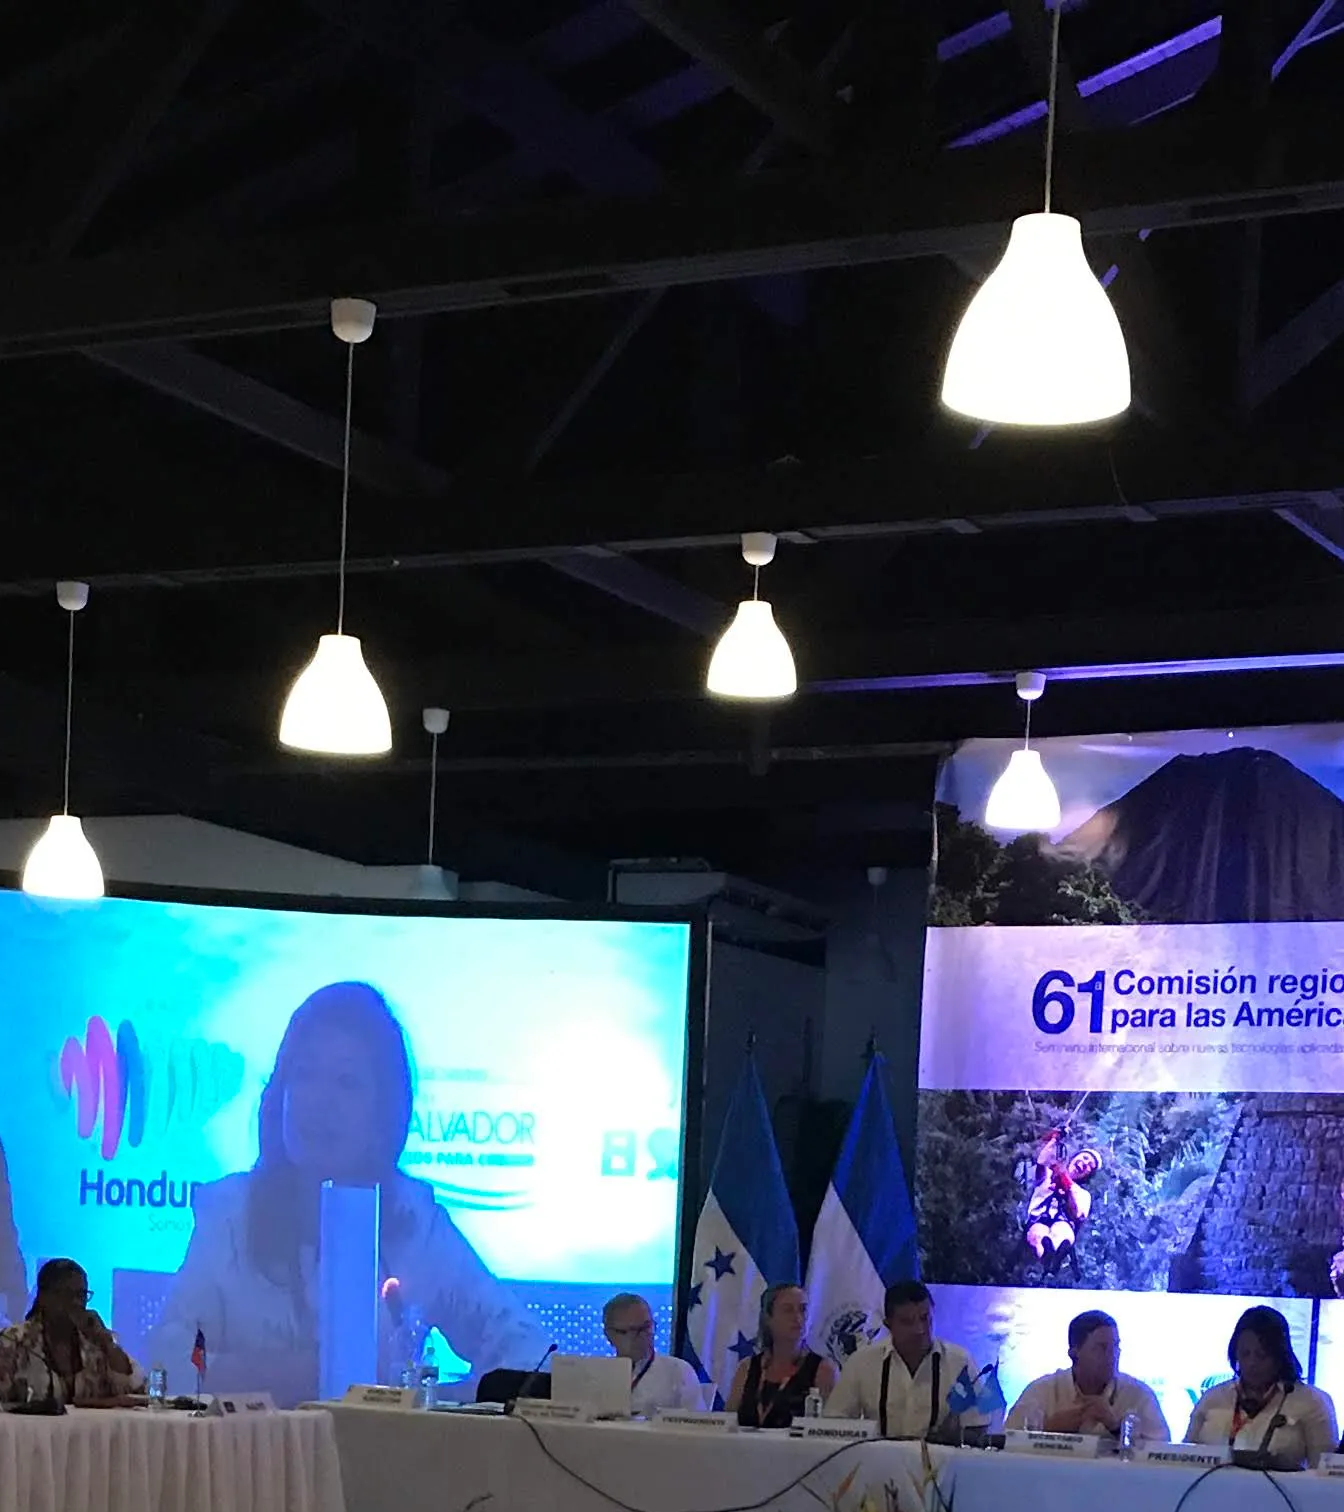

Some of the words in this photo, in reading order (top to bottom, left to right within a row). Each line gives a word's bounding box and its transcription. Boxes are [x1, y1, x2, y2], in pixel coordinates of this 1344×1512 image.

[1113, 966, 1257, 995] Comisión
[1031, 969, 1105, 1034] 61
[1110, 1005, 1177, 1033] para
[1185, 1002, 1226, 1028] las
[408, 1110, 535, 1144] ALVADOR
[80, 1168, 202, 1208] Hondur
[807, 1428, 868, 1438] HONDURAS
[1148, 1452, 1222, 1465] PRESIDENTE
